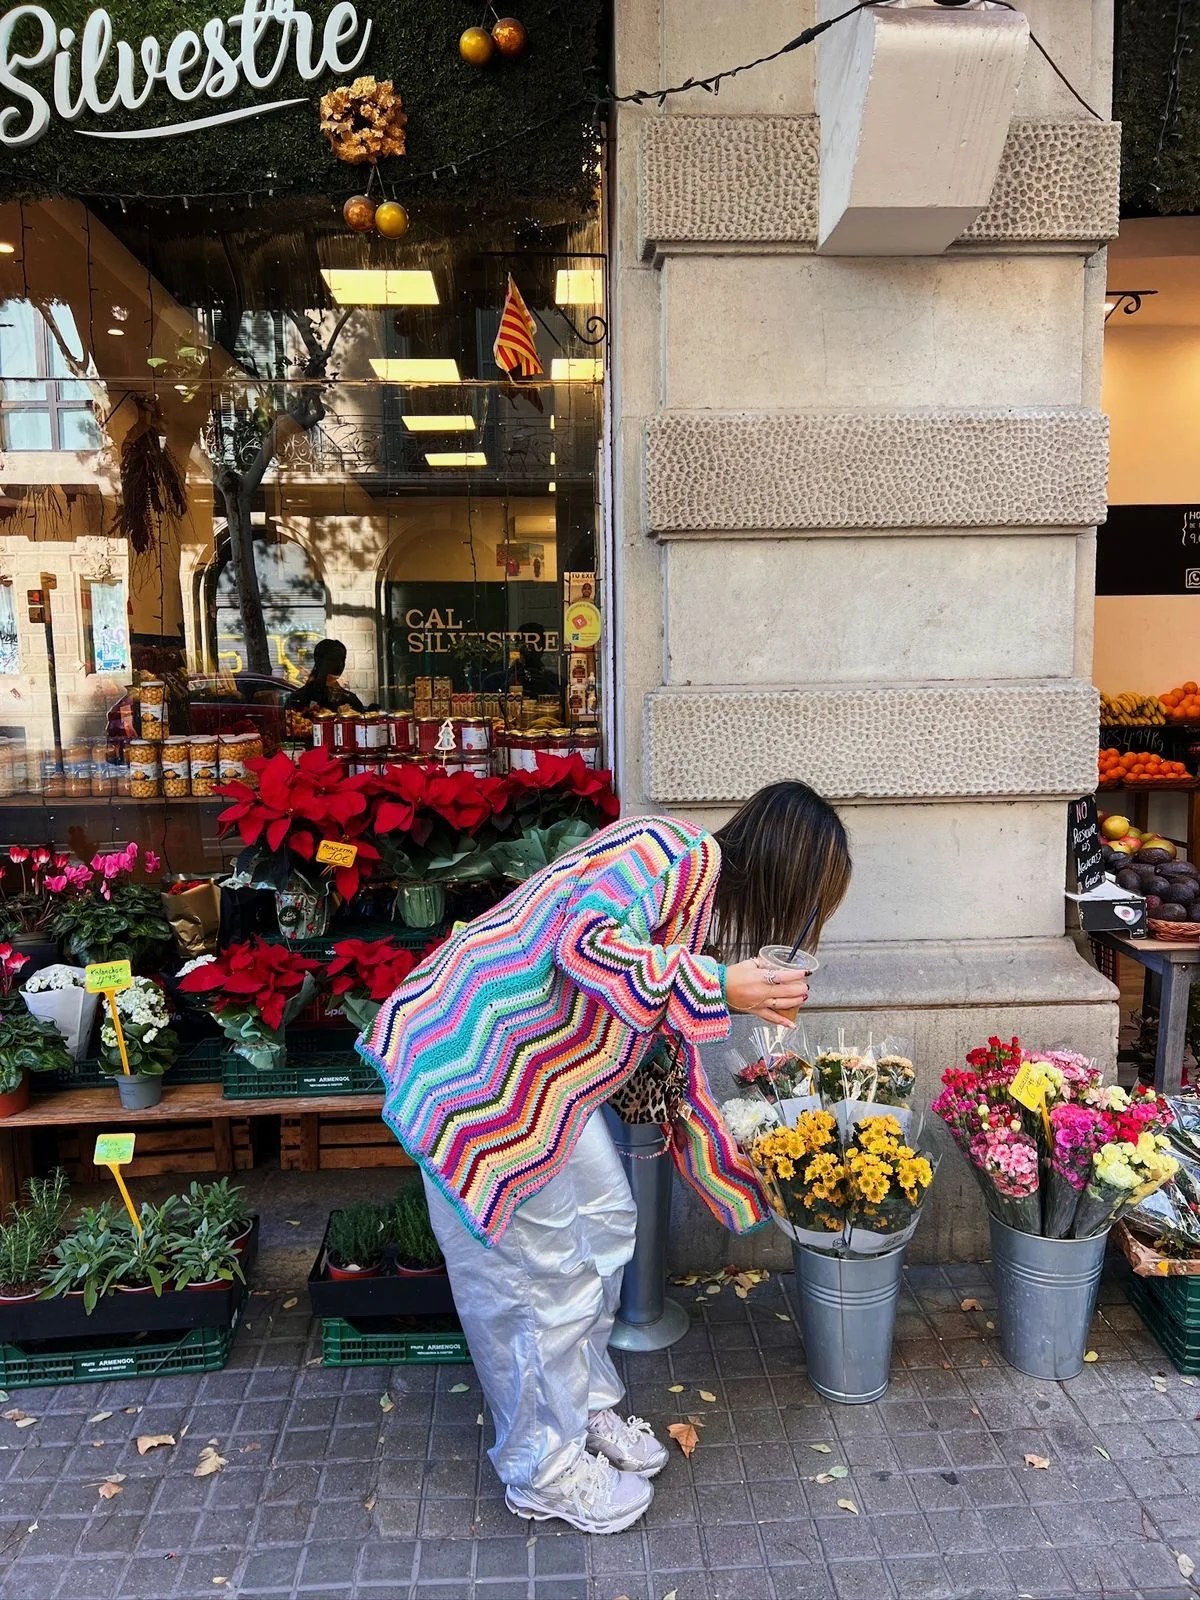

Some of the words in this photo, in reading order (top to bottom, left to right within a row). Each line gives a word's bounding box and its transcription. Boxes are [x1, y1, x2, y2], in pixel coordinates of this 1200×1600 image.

[0, 0, 373, 147] Silvestre
[405, 608, 463, 629] CAL
[1075, 801, 1088, 823] NO
[98, 1358, 135, 1366] ARMENGOL
